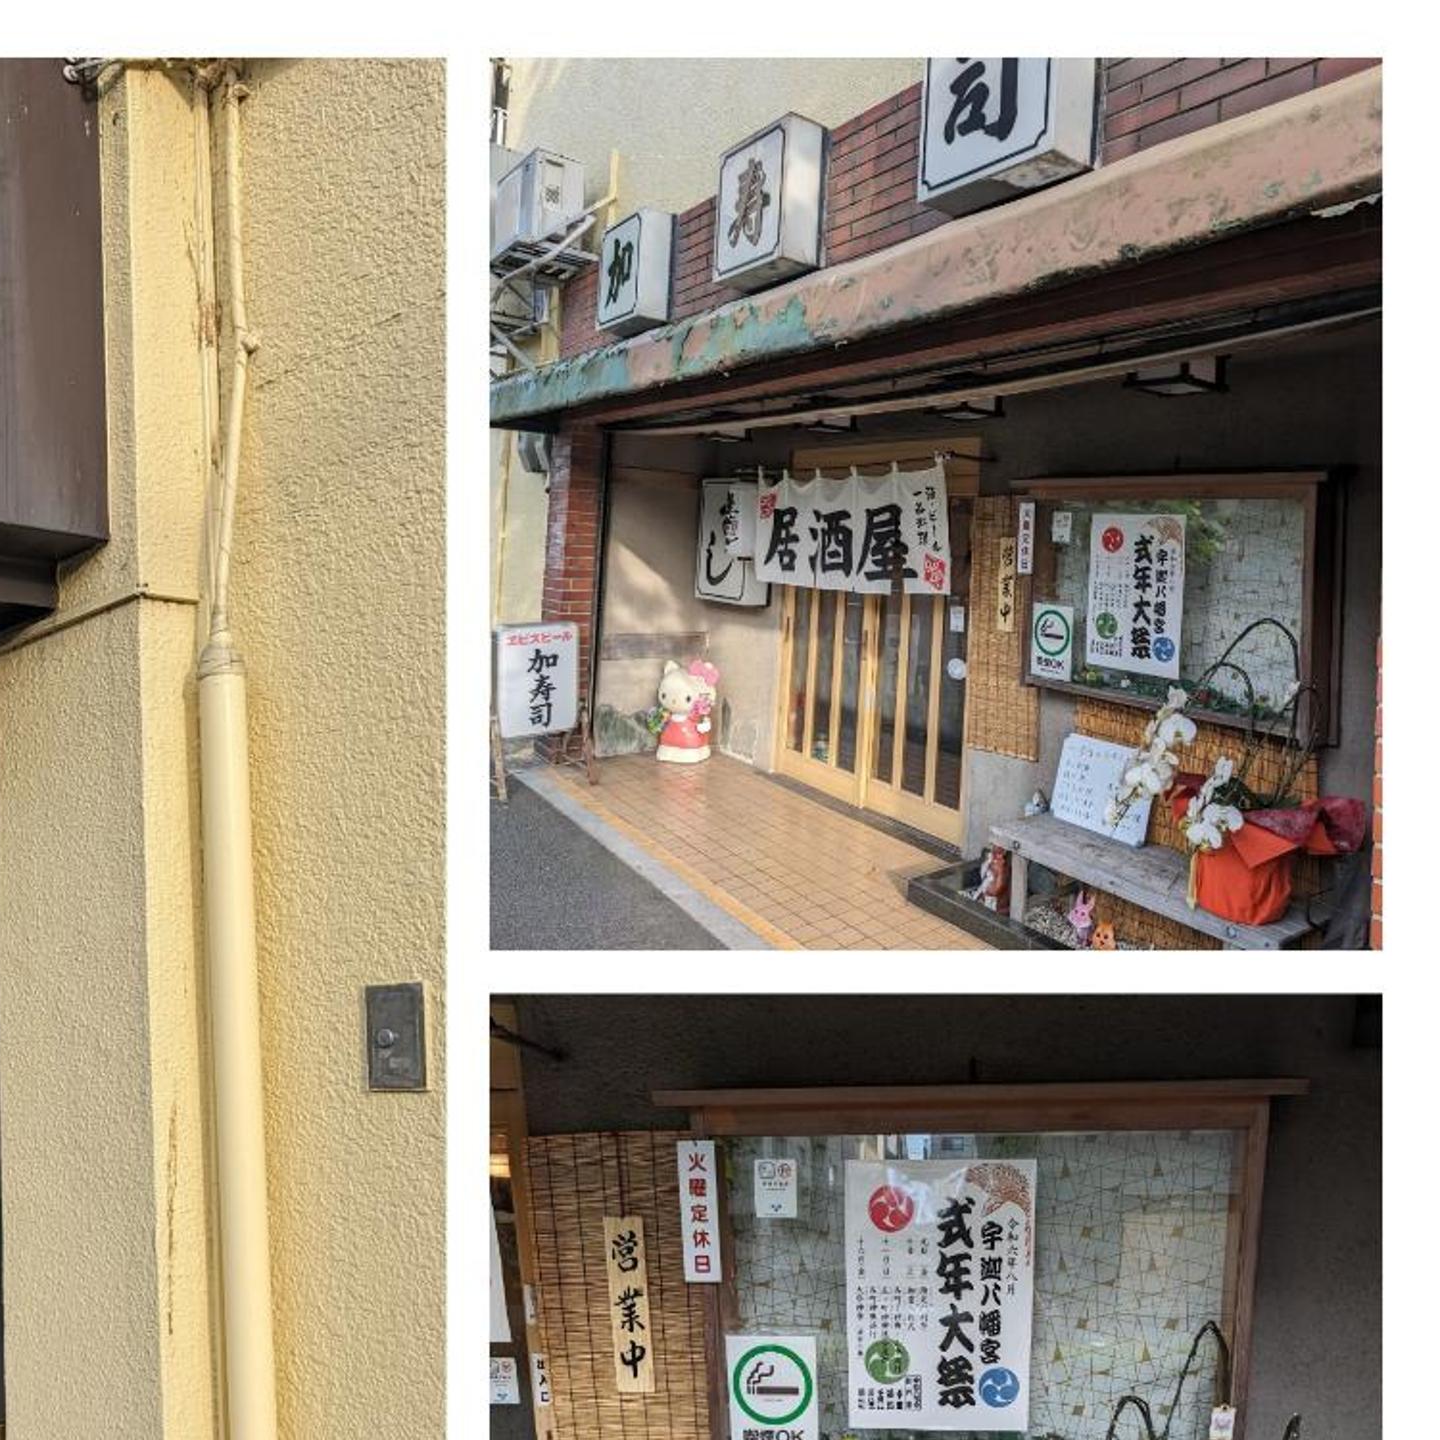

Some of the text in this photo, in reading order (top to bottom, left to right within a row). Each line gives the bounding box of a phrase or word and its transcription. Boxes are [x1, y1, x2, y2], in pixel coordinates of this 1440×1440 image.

[605, 238, 632, 308] 加
[763, 503, 918, 582] 居酒屋
[1130, 534, 1154, 660] 式年大祭
[527, 648, 559, 728] 加寿司
[687, 1152, 711, 1273] 火曜定休日
[611, 1230, 647, 1379] 営業中
[936, 1196, 977, 1408] 式年大祭
[979, 1220, 1005, 1365] 宇迦八幡宮
